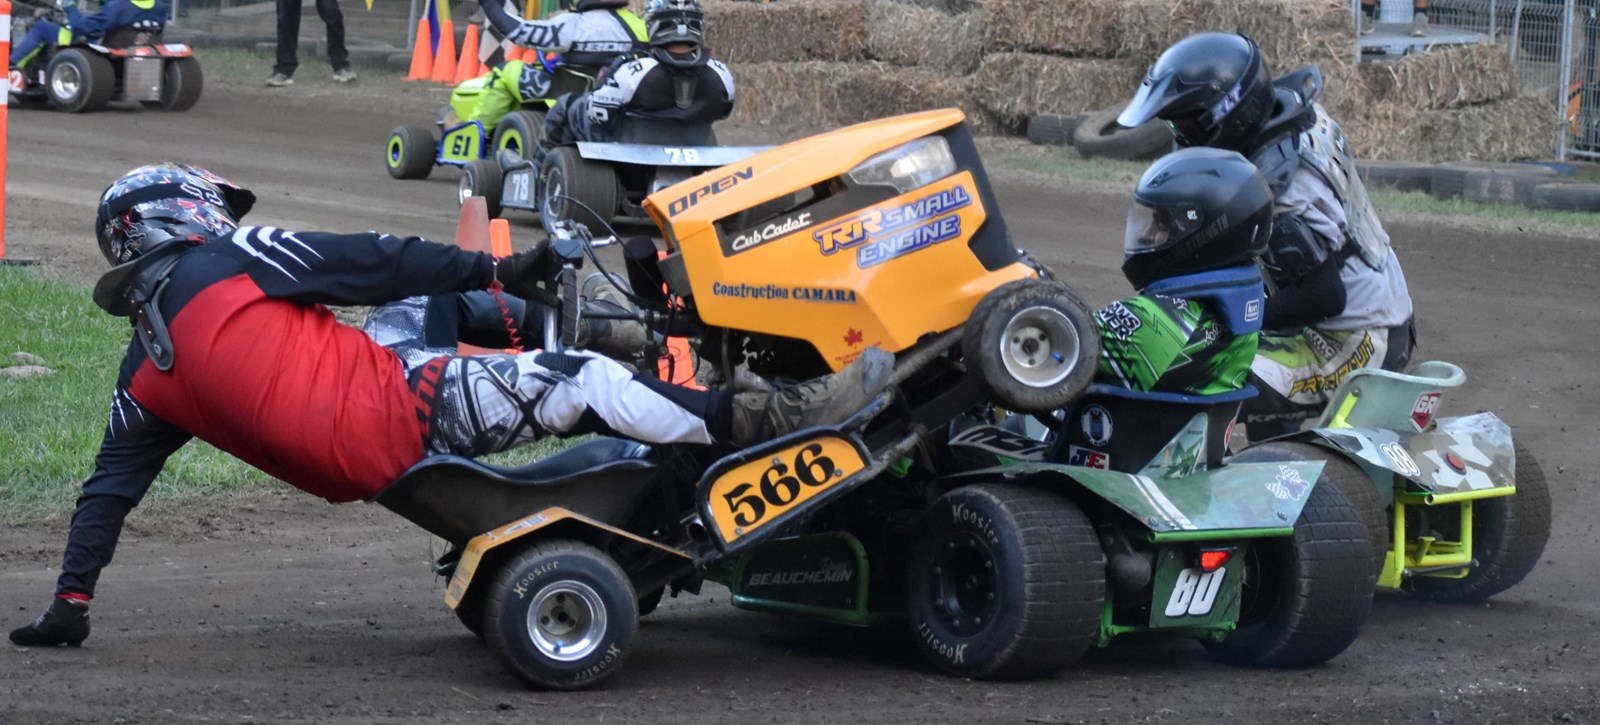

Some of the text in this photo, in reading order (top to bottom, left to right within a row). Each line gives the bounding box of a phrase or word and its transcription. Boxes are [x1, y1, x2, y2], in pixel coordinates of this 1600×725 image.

[509, 22, 565, 47] FOX
[451, 135, 471, 157] 61
[664, 148, 700, 164] 78
[512, 173, 530, 201] 78
[667, 166, 754, 218] OPEN
[731, 212, 811, 251] Cub Cadet
[813, 185, 972, 255] RR SMALL
[857, 215, 960, 269] ENGINE
[712, 282, 858, 303] Construction CAMARA
[1414, 393, 1441, 414] GR
[1381, 442, 1421, 477] 88
[722, 442, 835, 528] 566
[951, 503, 999, 545] Hoosier
[512, 560, 559, 600] Hoosier
[748, 568, 854, 586] BEAUCHEMIN
[1164, 566, 1226, 617] 80
